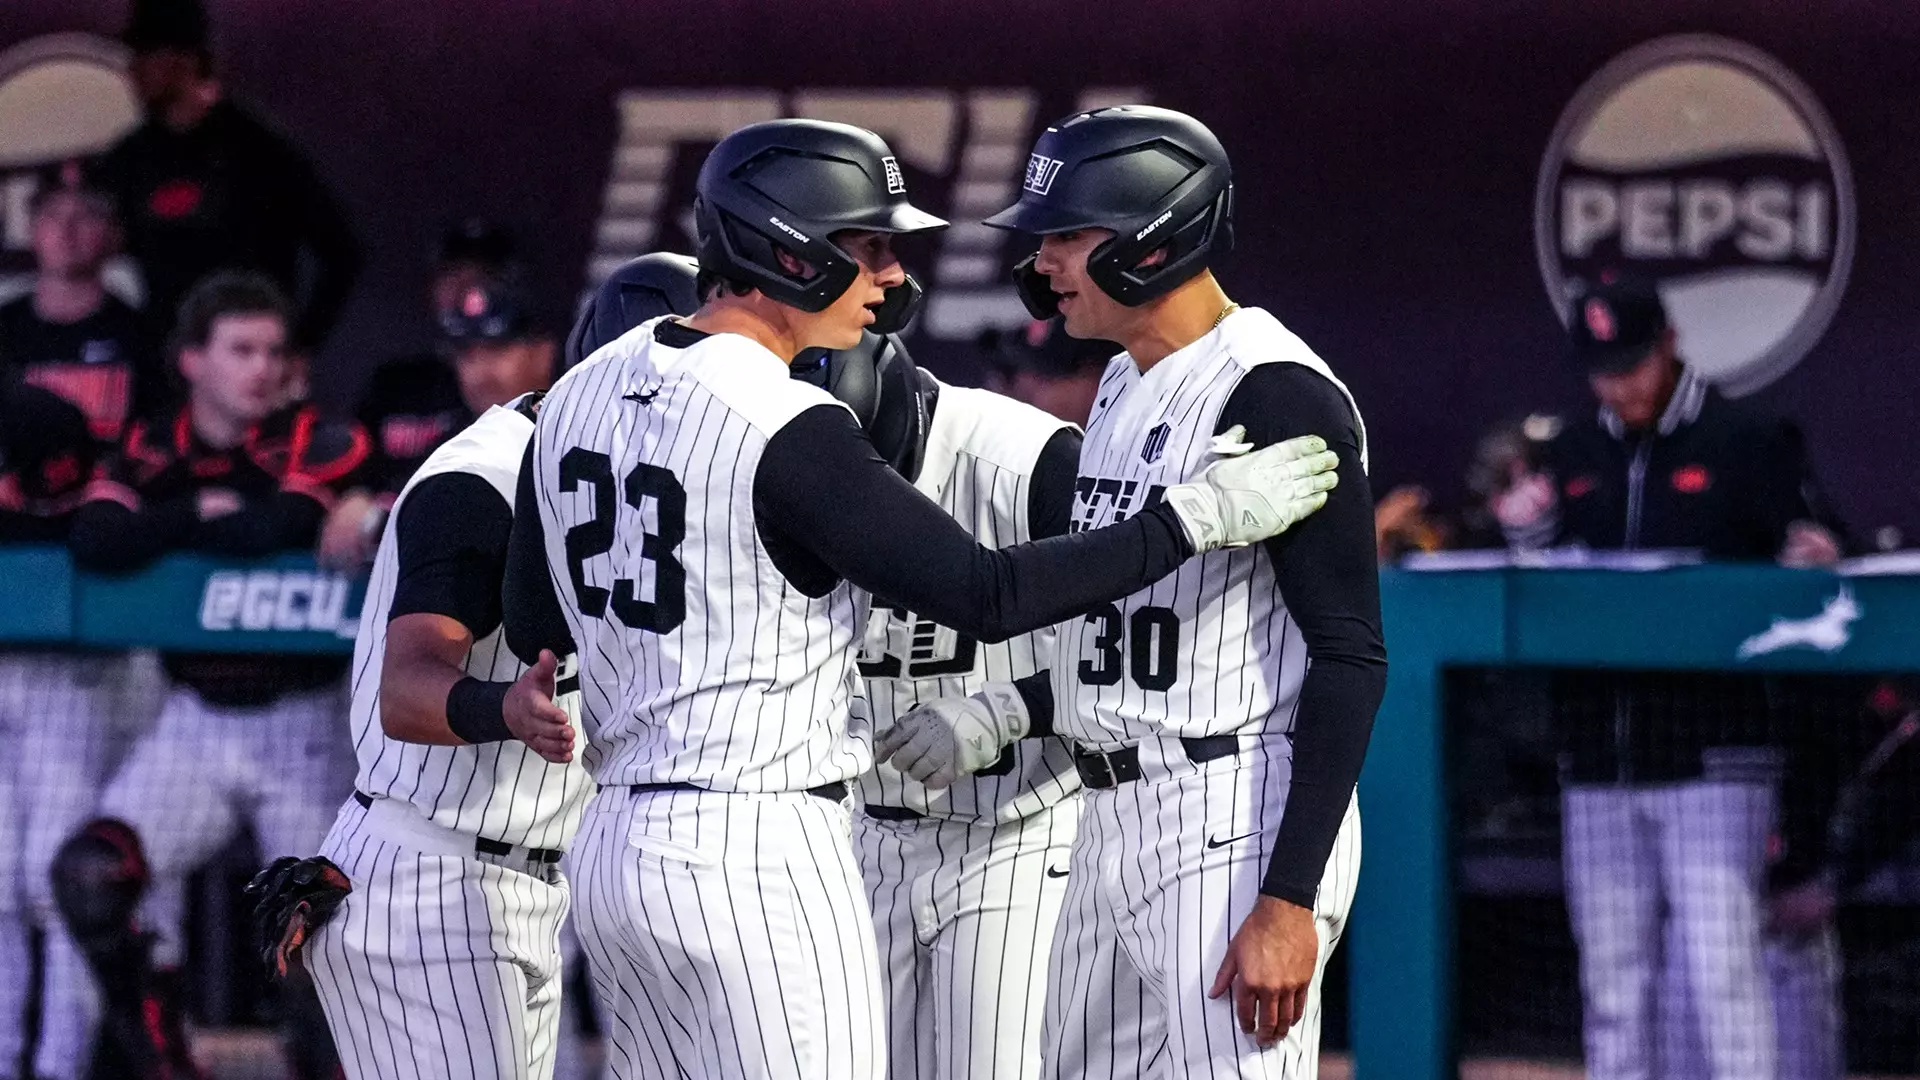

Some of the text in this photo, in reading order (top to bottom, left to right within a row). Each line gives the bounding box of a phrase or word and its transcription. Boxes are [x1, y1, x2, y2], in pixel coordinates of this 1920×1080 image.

[769, 216, 811, 243] EASTON
[1136, 210, 1173, 241] EASTON
[1560, 178, 1831, 260] PEPSI
[559, 446, 687, 635] 23
[1078, 602, 1180, 692] 30
